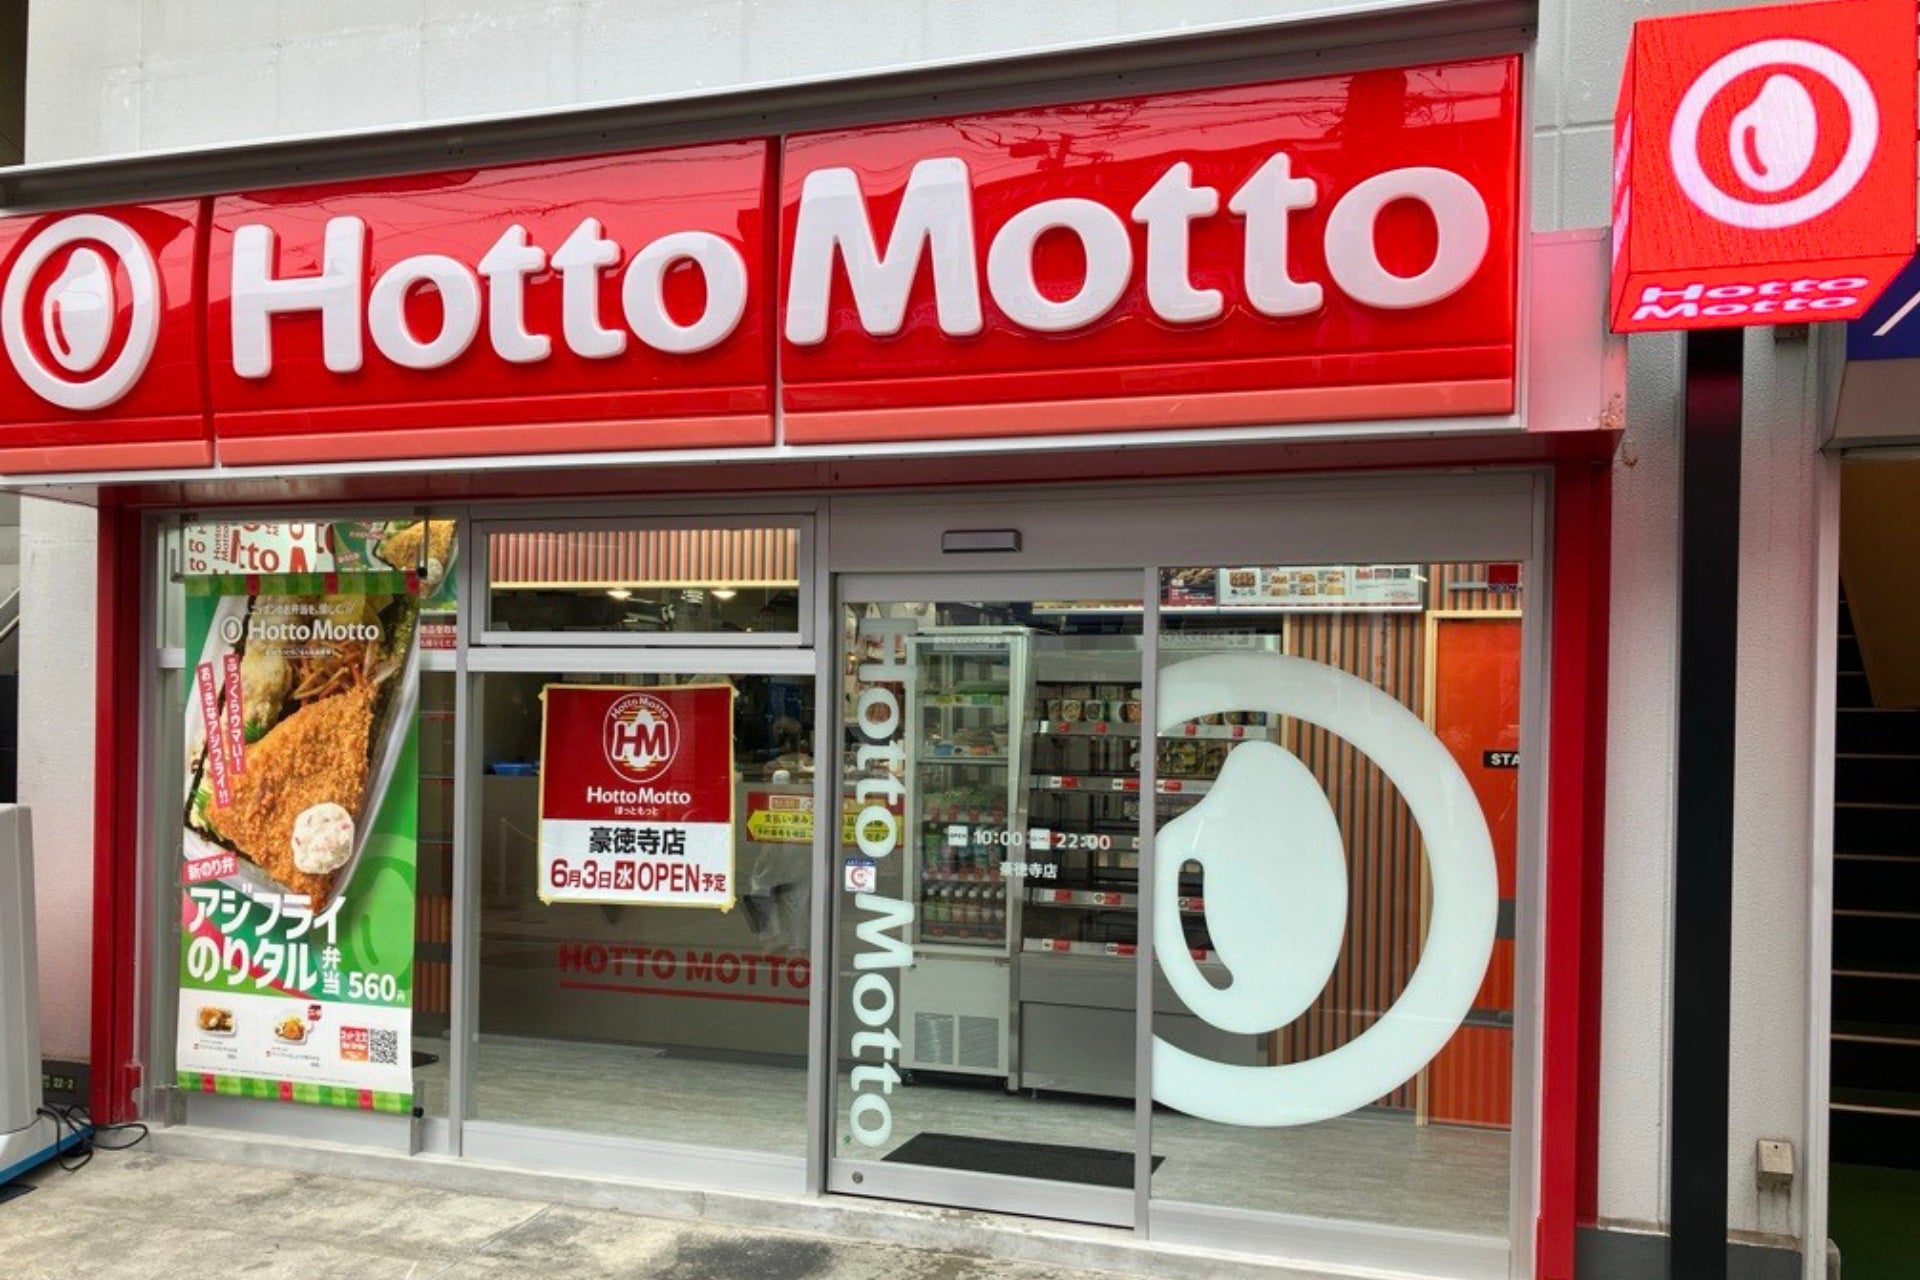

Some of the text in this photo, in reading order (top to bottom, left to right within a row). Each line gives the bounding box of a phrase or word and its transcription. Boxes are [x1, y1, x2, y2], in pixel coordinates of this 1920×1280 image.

[231, 216, 748, 379] Hotto
[785, 152, 1491, 346] Motto
[1641, 278, 1869, 304] Hotto
[1632, 297, 1858, 321] Motto
[248, 619, 379, 641] Hotto Motto
[855, 617, 917, 858] Hotto
[587, 786, 691, 805] Hotto Motto
[614, 806, 660, 816] ほっともっと
[589, 826, 686, 856] 豪徳寺店
[973, 831, 1022, 846] 10:00
[1056, 833, 1111, 850] 22:00
[187, 857, 235, 881] 新のり弁
[188, 883, 347, 944] アジフライ
[187, 936, 317, 992] のりタル
[322, 946, 342, 996] 弁当
[558, 943, 810, 989] HOTTO MOTTO
[850, 893, 915, 1148] Motto
